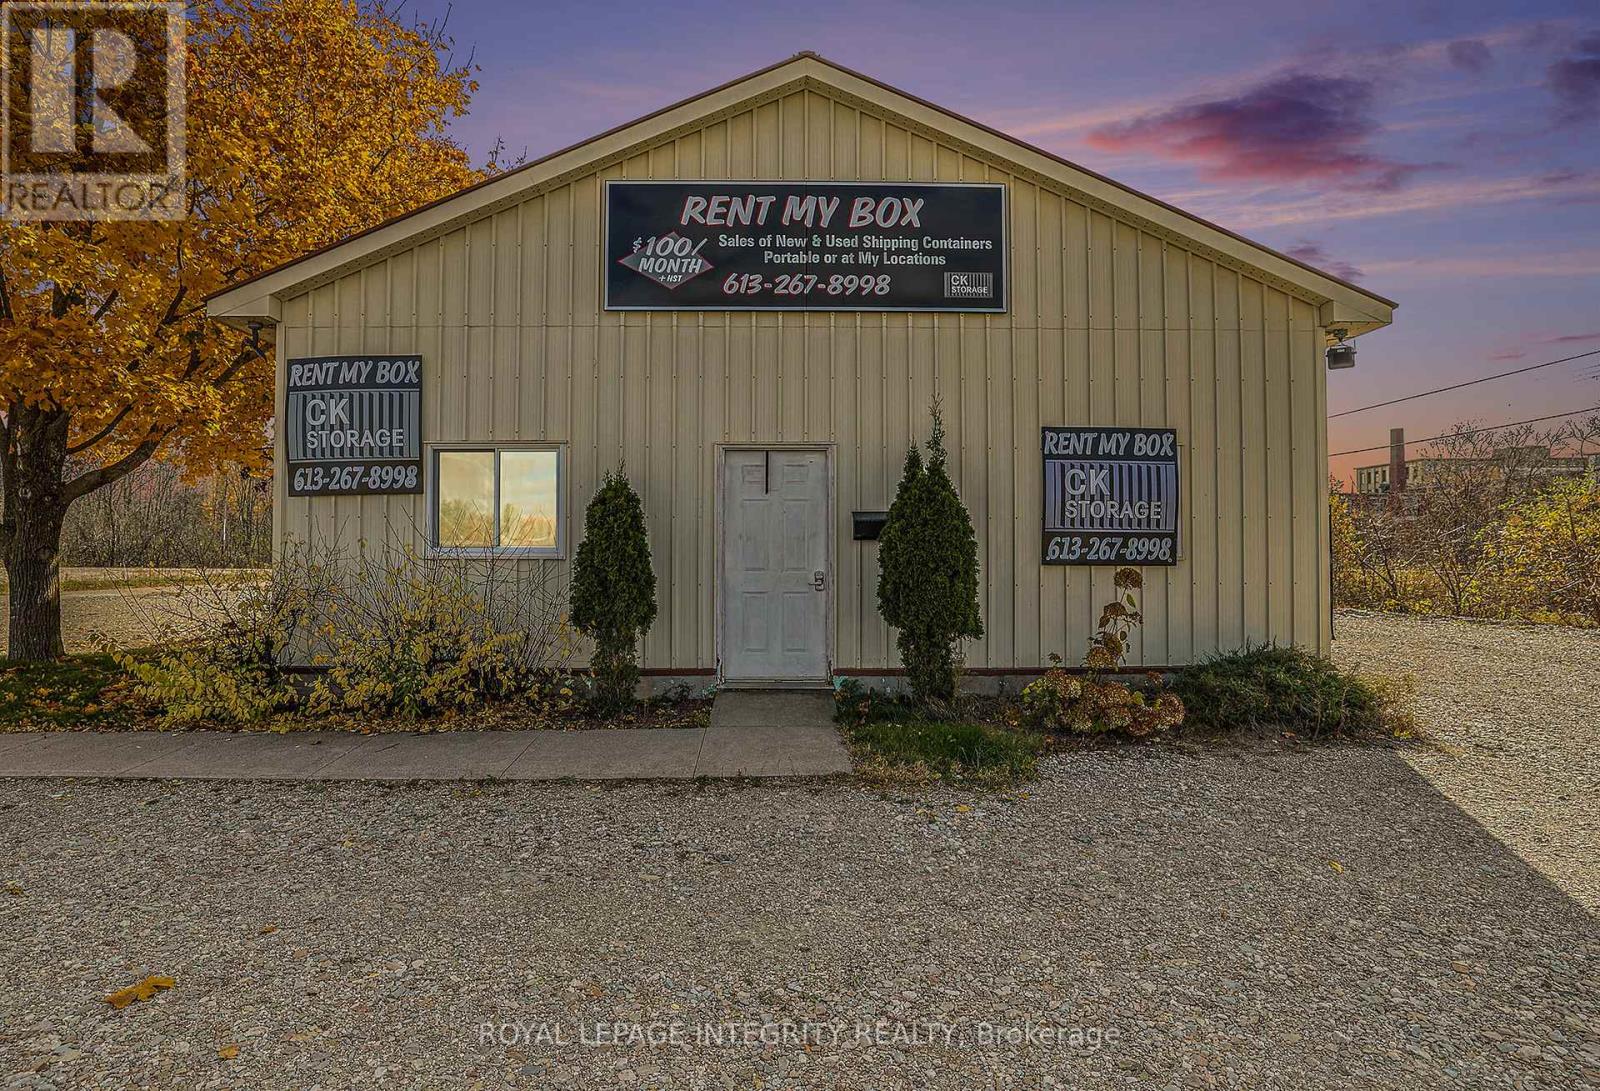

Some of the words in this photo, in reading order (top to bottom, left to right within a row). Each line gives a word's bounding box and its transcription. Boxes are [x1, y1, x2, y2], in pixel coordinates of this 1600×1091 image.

[681, 195, 776, 227] RENT
[782, 195, 840, 228] MY
[849, 196, 924, 229] BOX
[719, 234, 754, 248] Sales
[759, 234, 772, 248] of
[776, 235, 807, 248] New
[812, 235, 822, 248] &
[826, 235, 859, 249] Used
[863, 235, 918, 251] Shipping
[923, 236, 993, 250] Containers
[638, 257, 703, 274] MONTH
[764, 251, 820, 264] Portable
[824, 254, 838, 264] or
[841, 252, 855, 265] at
[859, 252, 880, 267] My
[884, 252, 946, 266] Locations
[723, 273, 891, 296] 613-267-8998
[951, 275, 968, 286] CK
[951, 286, 988, 294] STORAGE
[289, 362, 339, 387] RENT
[338, 361, 373, 385] MY
[375, 361, 420, 384] BOX
[305, 398, 350, 426] CK
[306, 429, 404, 449] STORAGE
[1044, 431, 1097, 455] RENT
[1098, 432, 1130, 456] MY
[1133, 433, 1174, 456] BOX
[294, 465, 418, 491] 613-267-8998
[1065, 468, 1110, 496] CK
[1065, 500, 1162, 519] STORAGE
[1047, 536, 1172, 560] 613-267-8998
